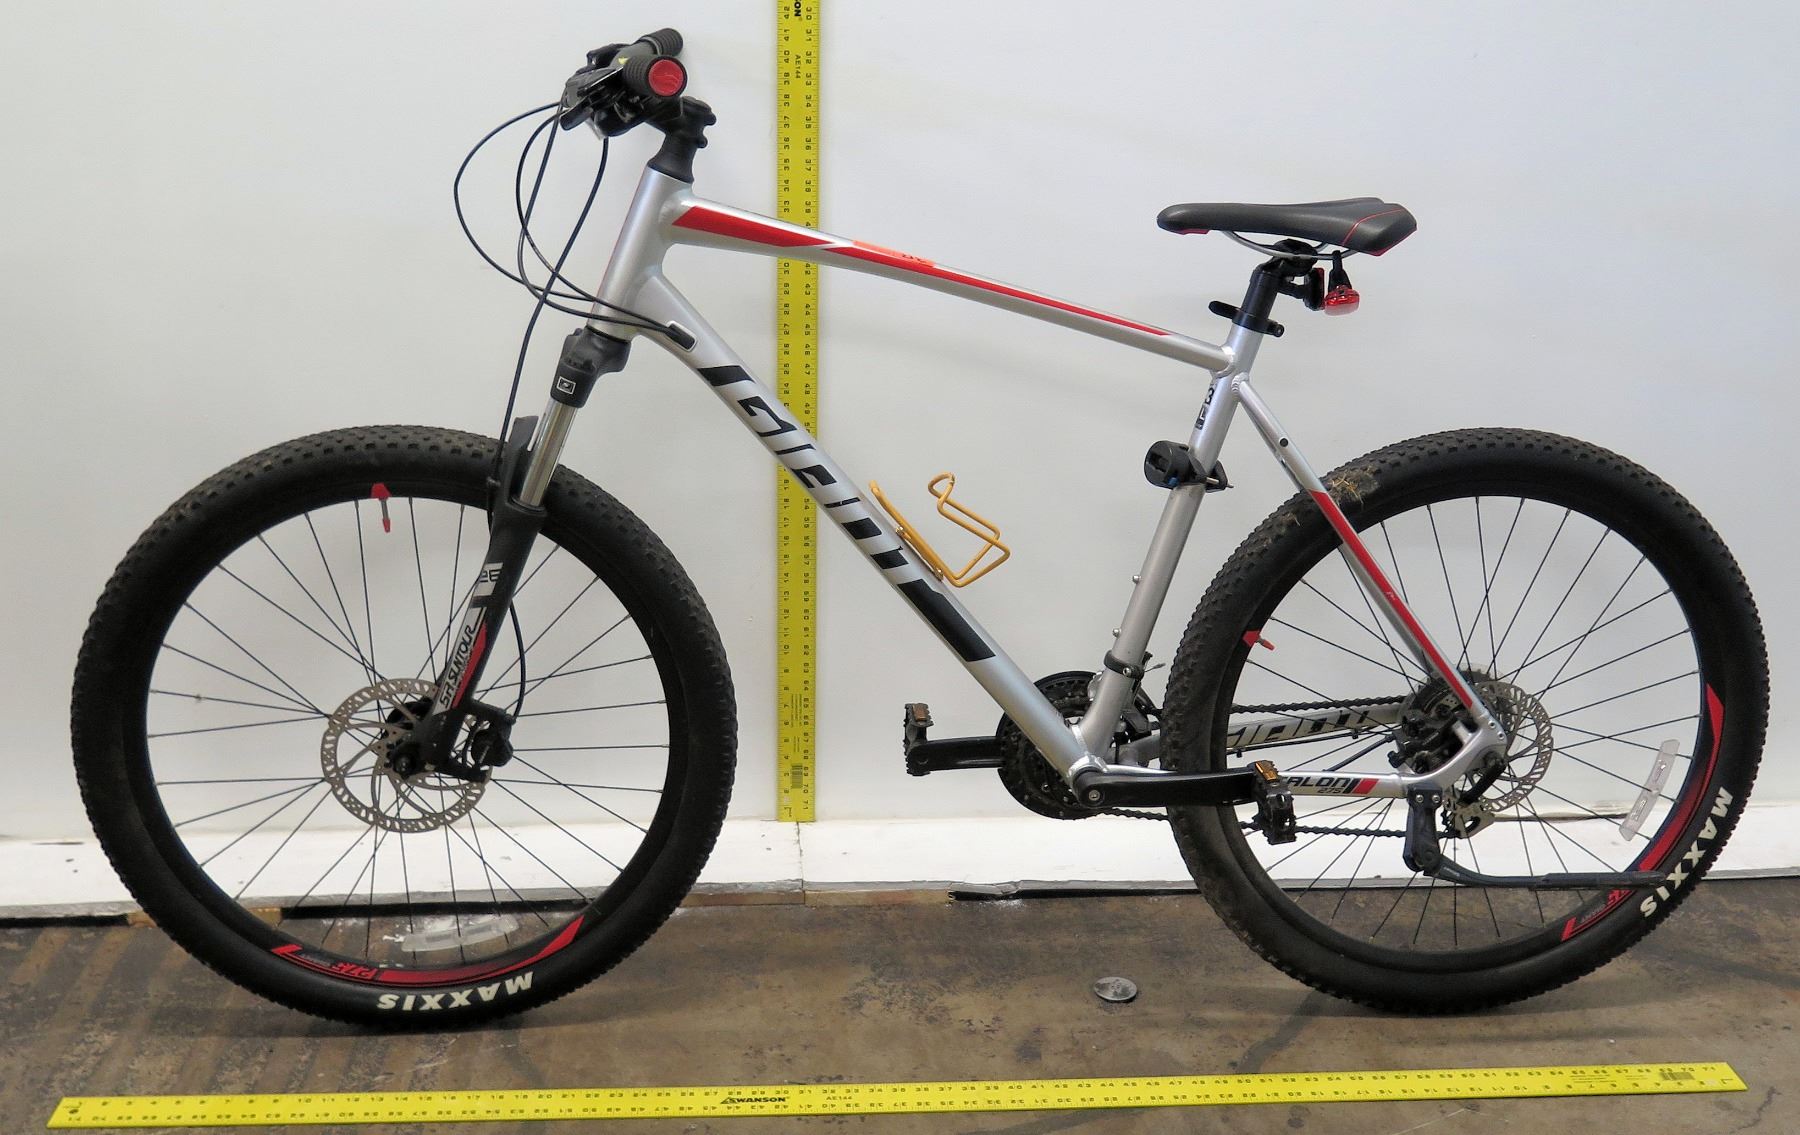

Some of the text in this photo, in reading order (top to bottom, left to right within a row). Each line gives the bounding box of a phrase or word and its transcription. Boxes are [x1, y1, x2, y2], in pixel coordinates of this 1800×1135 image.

[806, 7, 812, 20] 30
[806, 29, 812, 42] 31
[806, 51, 812, 64] 32
[806, 73, 812, 86] 33
[806, 95, 812, 108] 34
[806, 116, 812, 129] 35
[806, 138, 811, 151] 36
[805, 159, 811, 172] 37
[805, 180, 811, 193] 38
[805, 201, 811, 214] 39
[805, 263, 811, 275] 42
[805, 283, 811, 296] 43
[805, 304, 811, 316] 44
[805, 324, 811, 336] 45
[805, 344, 811, 356] 46
[805, 363, 810, 375] 47
[805, 383, 810, 395] 48
[805, 403, 810, 414] 49
[449, 624, 474, 683] SUNTOUR
[1640, 786, 1734, 918] MAXXIS
[376, 971, 534, 1011] MAXXIS
